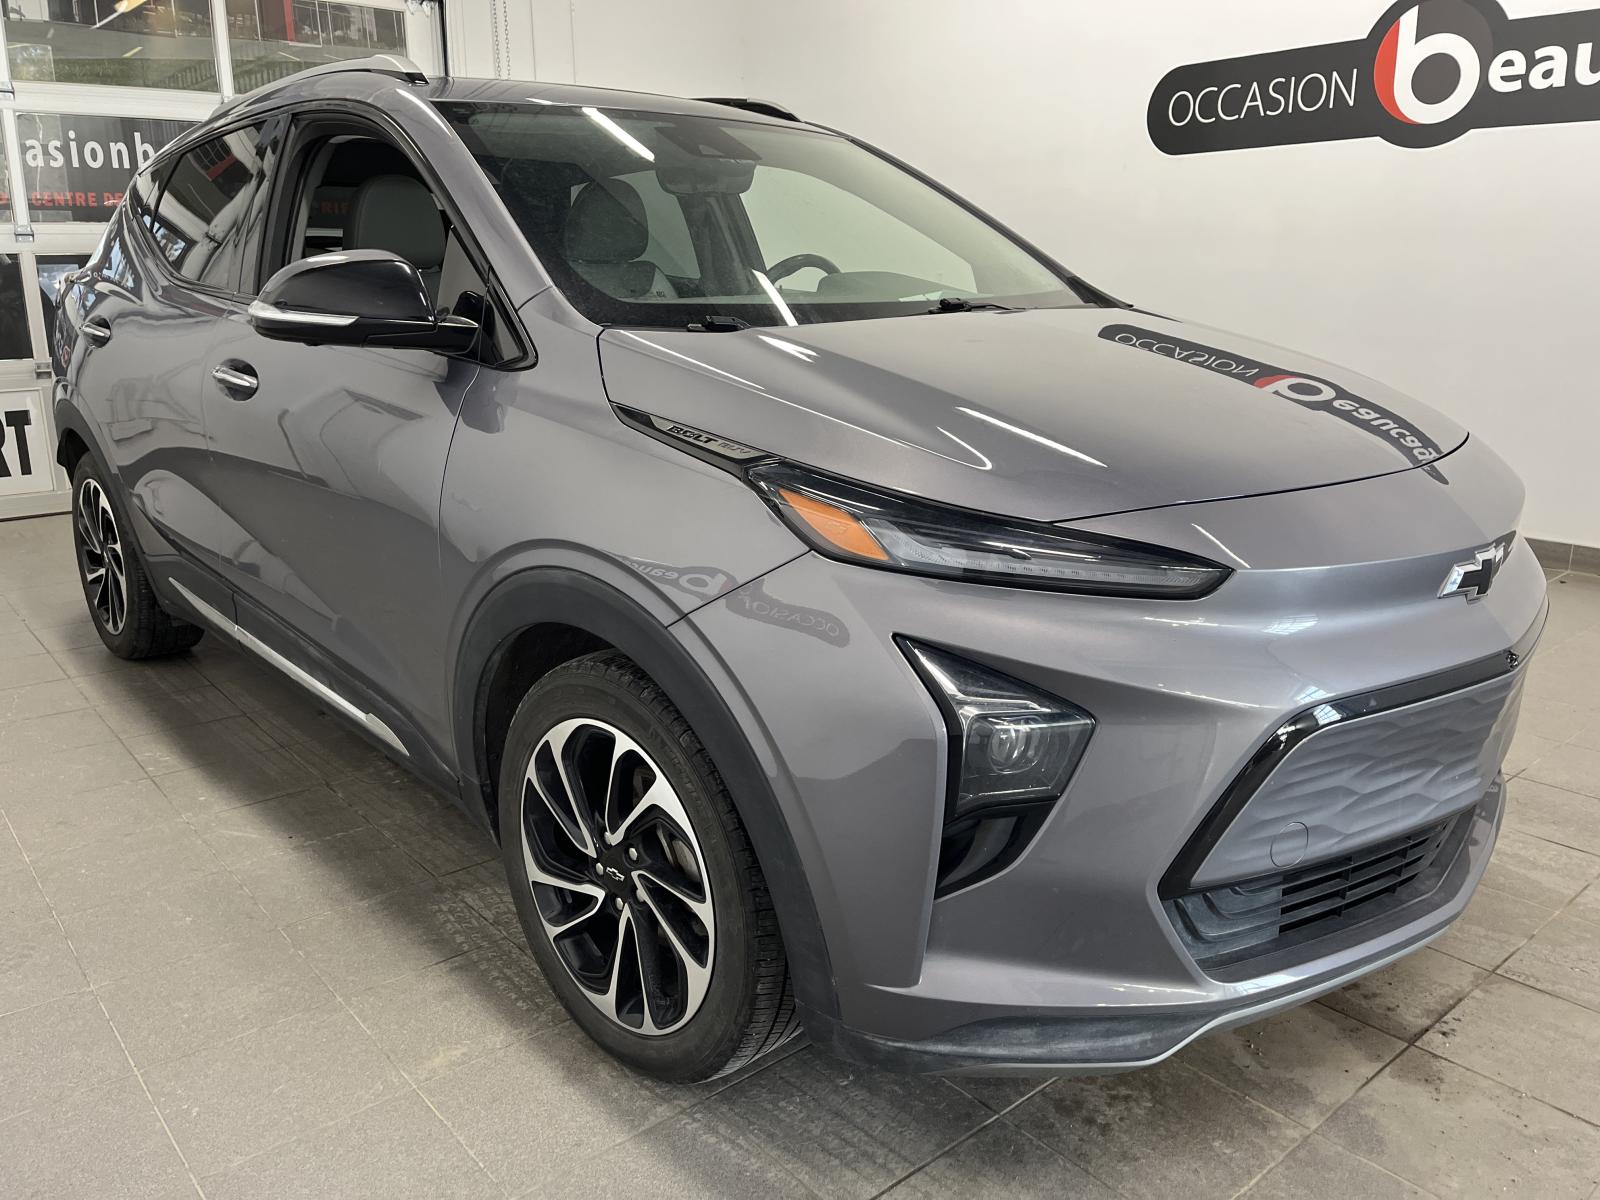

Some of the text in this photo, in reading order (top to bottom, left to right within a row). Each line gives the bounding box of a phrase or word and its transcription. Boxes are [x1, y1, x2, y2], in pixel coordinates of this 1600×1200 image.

[1168, 68, 1358, 126] OCCASION
[31, 191, 98, 207] CENTRE
[667, 425, 719, 443] BOLT
